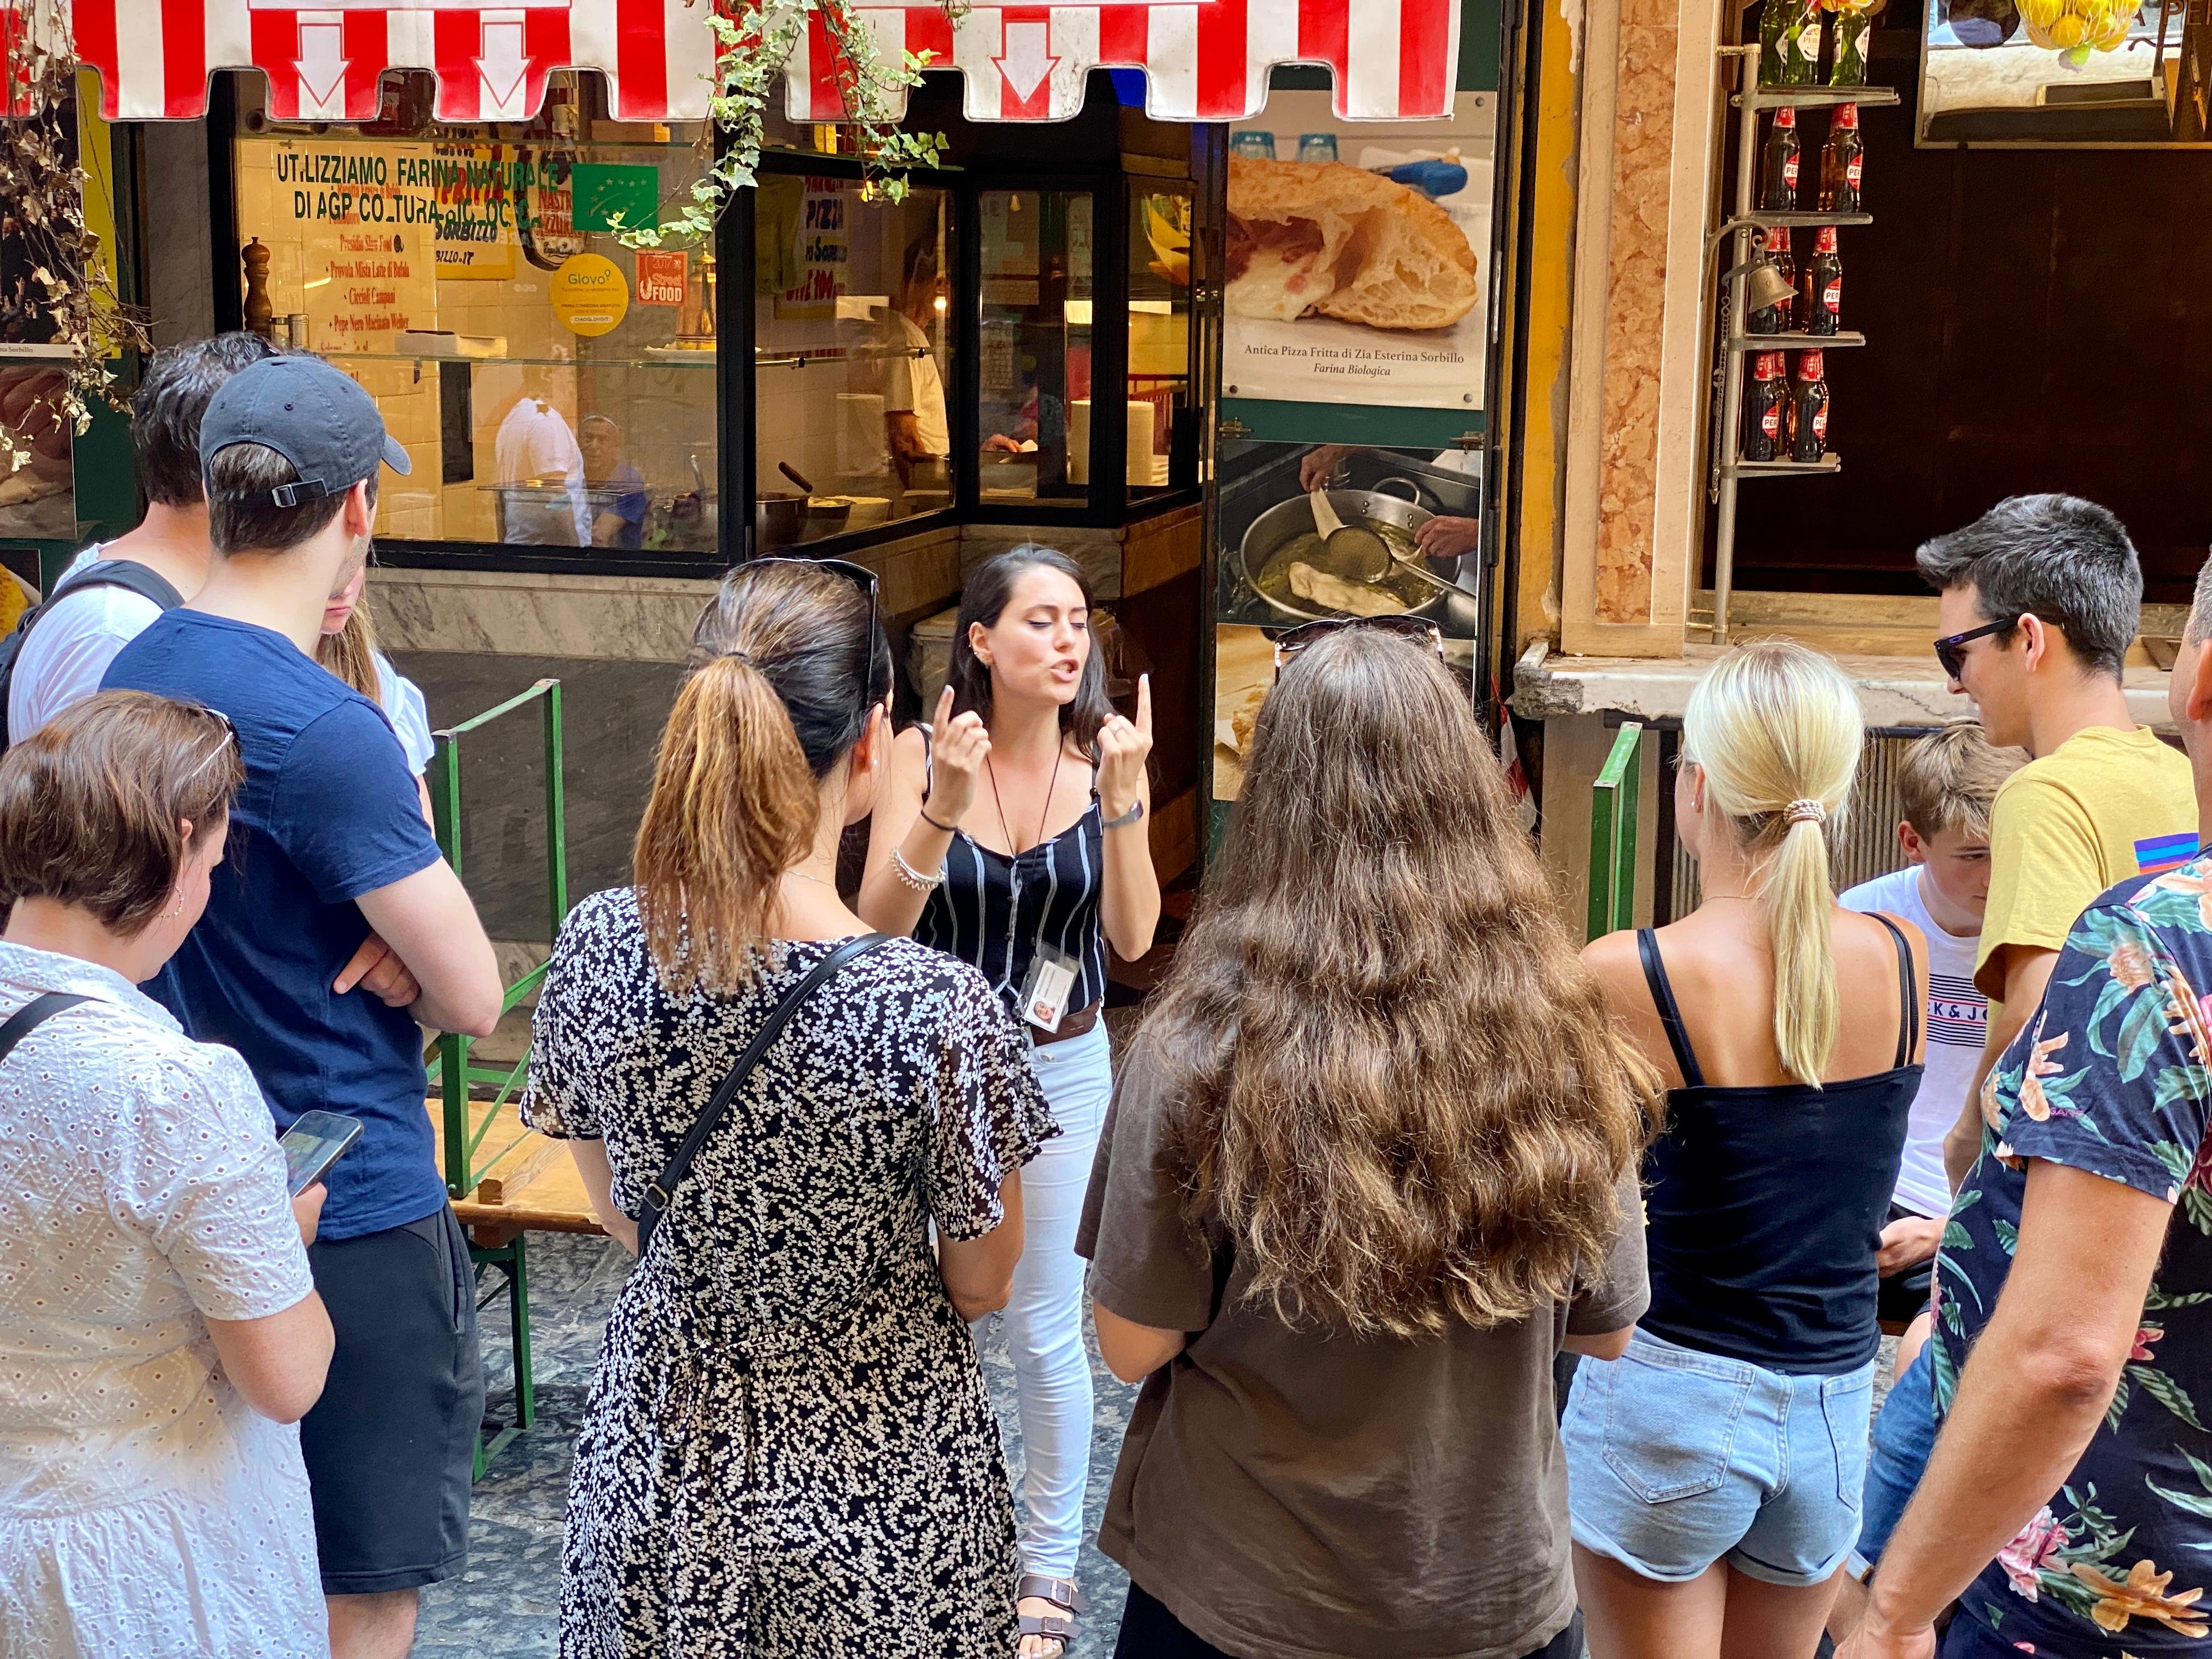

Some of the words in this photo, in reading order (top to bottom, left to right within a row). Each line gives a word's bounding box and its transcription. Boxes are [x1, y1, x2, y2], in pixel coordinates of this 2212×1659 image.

[397, 157, 459, 188] FARINA
[294, 190, 311, 219] DI
[568, 273, 605, 285] Glovo
[652, 286, 682, 302] FOOD
[1245, 345, 1278, 356] Antica
[1282, 346, 1307, 357] Pizza
[1310, 347, 1339, 358] Fritta
[1342, 347, 1352, 359] di
[1355, 349, 1372, 360] Zia
[1375, 350, 1418, 362] Esterina
[1420, 352, 1464, 364] Sorbillo
[1314, 363, 1345, 374] Farina
[1347, 364, 1390, 378] Biologica
[1949, 1005, 1960, 1018] &
